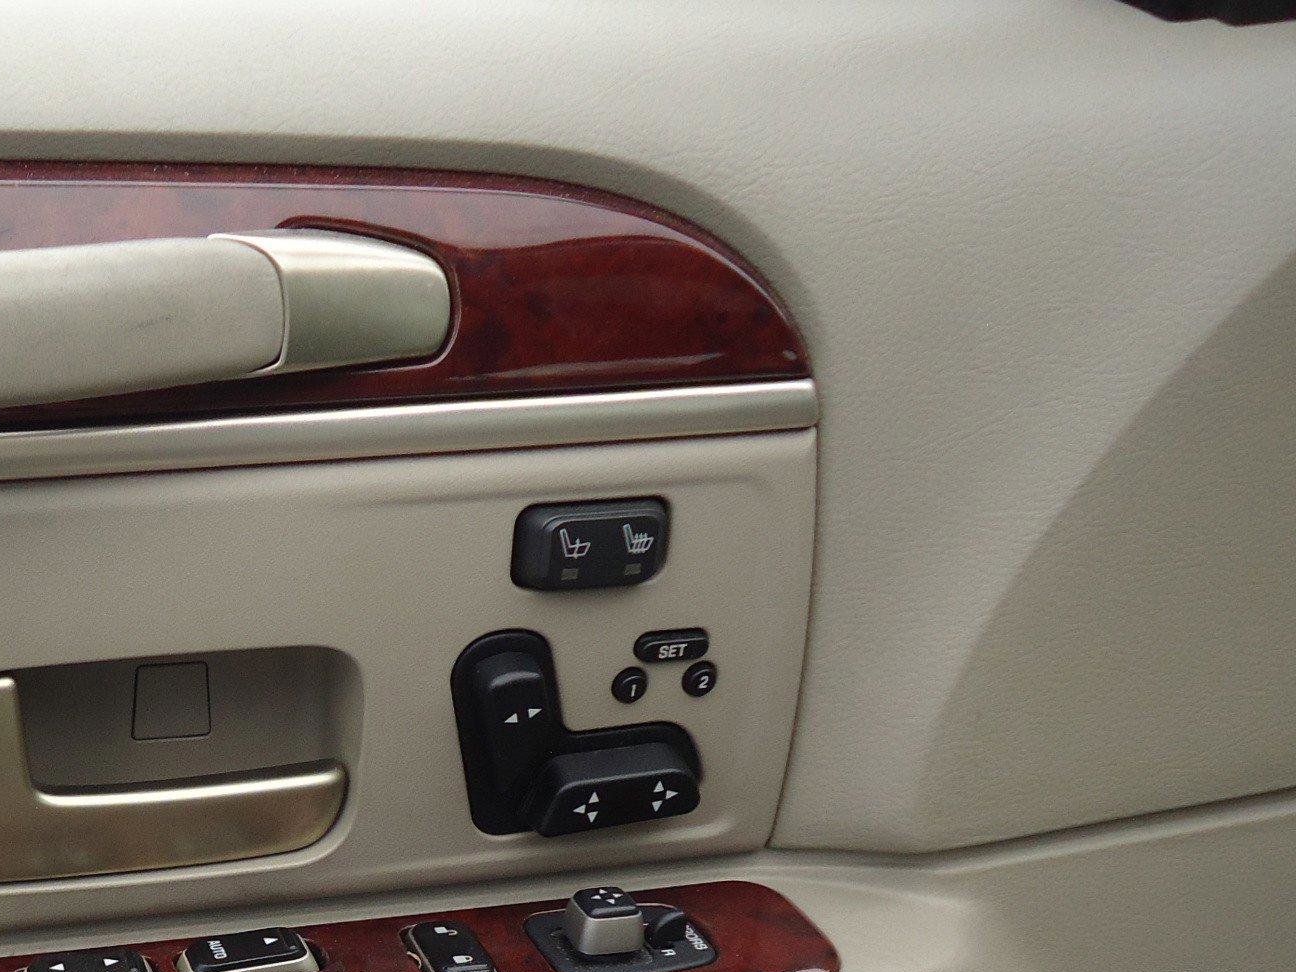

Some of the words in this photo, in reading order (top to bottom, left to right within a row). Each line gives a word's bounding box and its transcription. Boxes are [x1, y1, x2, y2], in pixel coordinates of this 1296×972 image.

[658, 643, 688, 659] SET
[698, 675, 709, 689] 2
[630, 684, 637, 697] 1
[206, 940, 228, 960] AUTO
